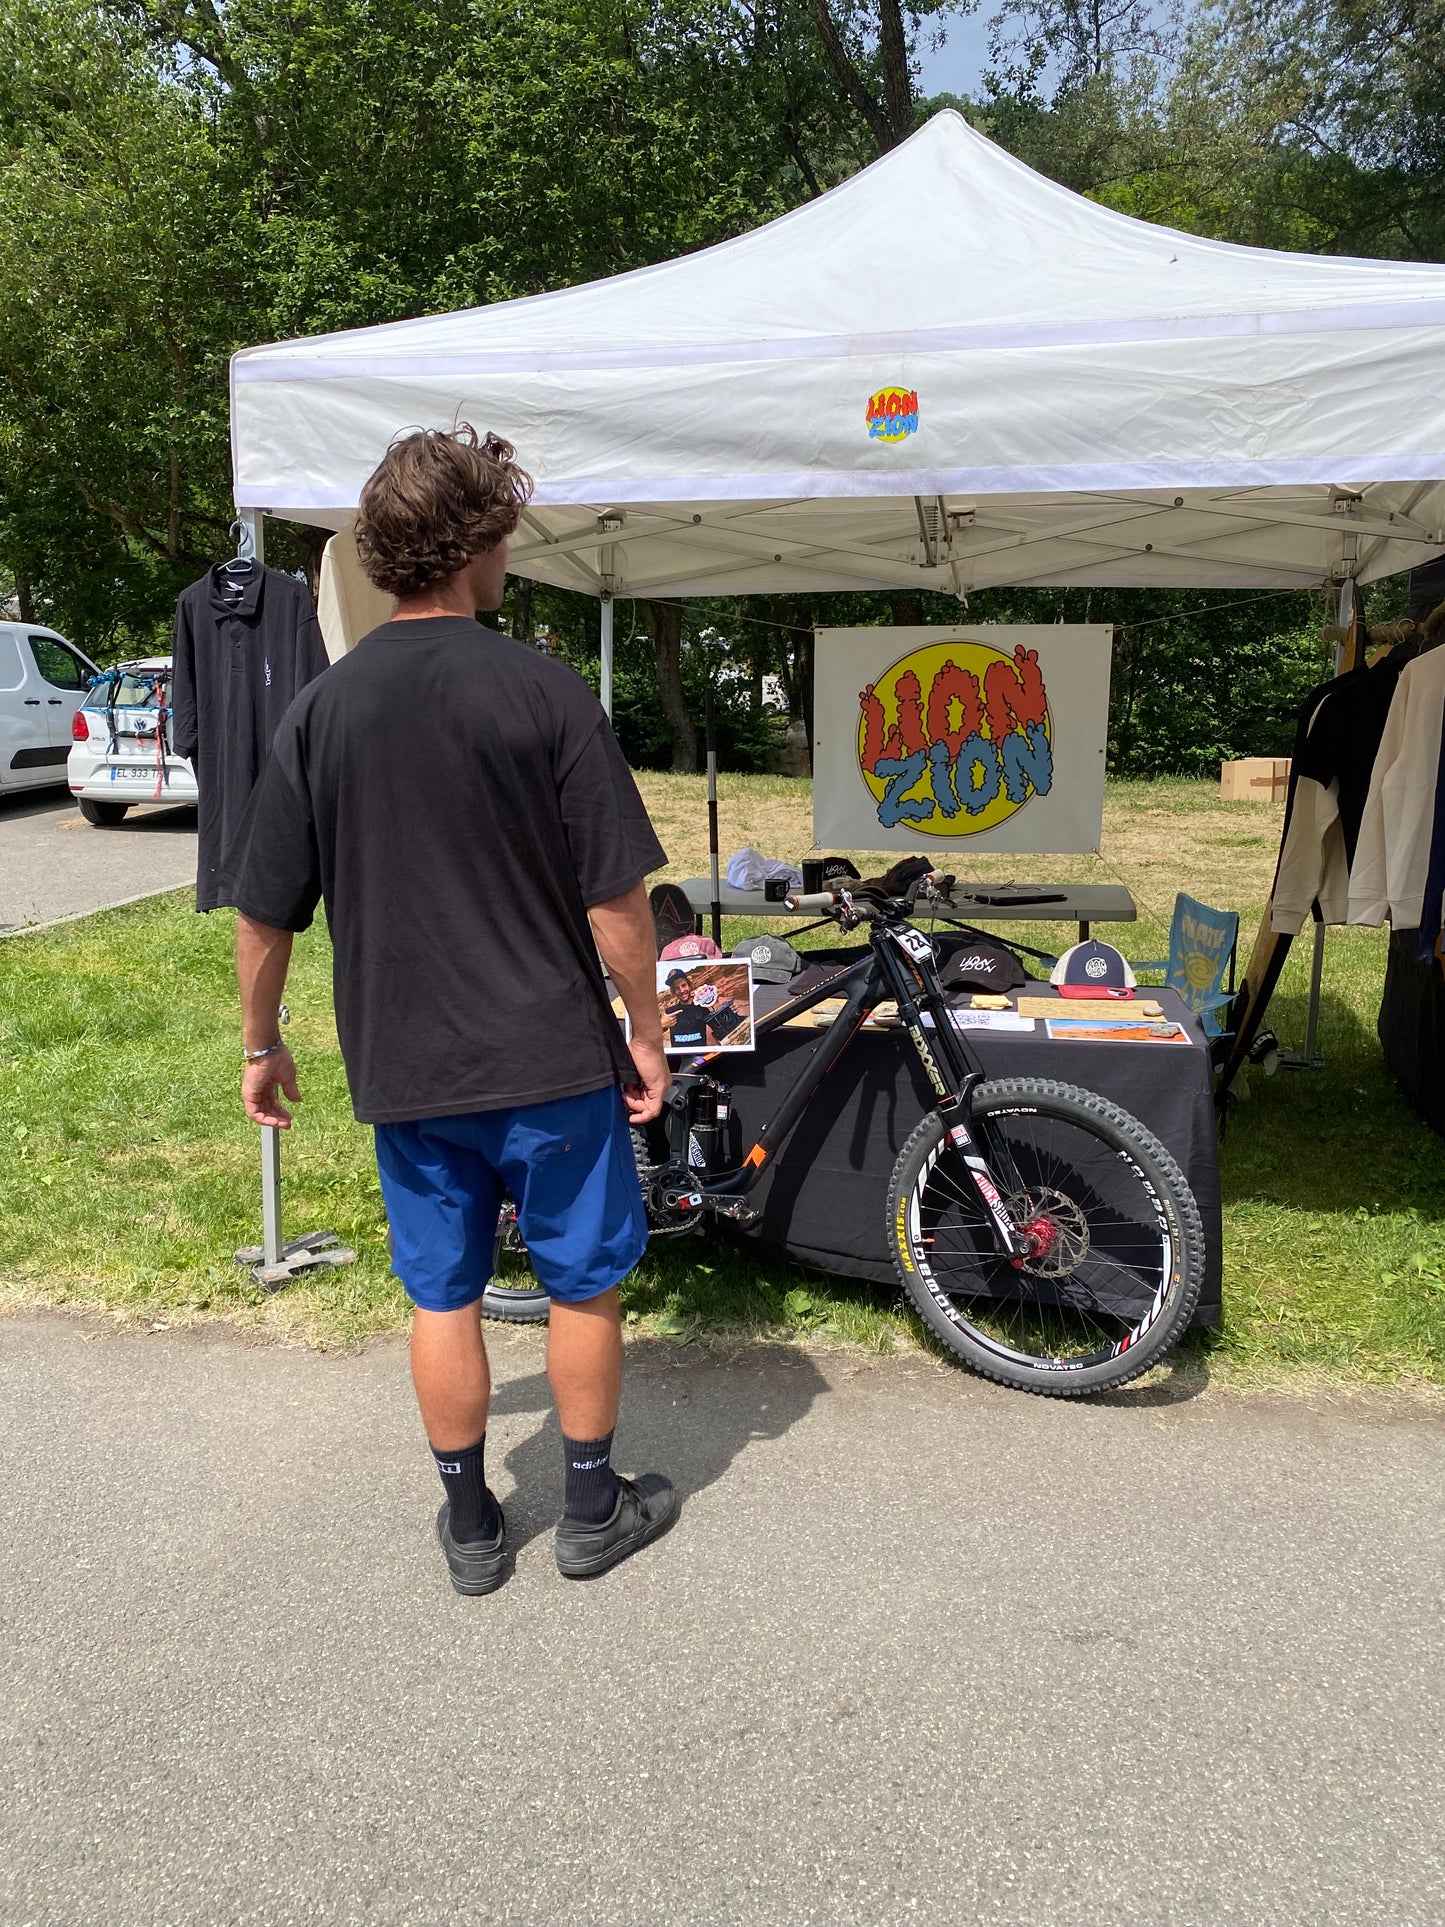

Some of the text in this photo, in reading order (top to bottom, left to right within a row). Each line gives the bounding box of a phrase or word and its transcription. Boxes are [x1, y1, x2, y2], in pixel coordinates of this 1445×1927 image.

[866, 390, 918, 420] LION
[868, 411, 918, 438] ZION
[859, 644, 1047, 774] LION
[874, 719, 1054, 828] ZION
[908, 1024, 946, 1096] BOXXER
[987, 1108, 1037, 1116] NOVATEC
[1033, 1362, 1084, 1371] NOVATEC
